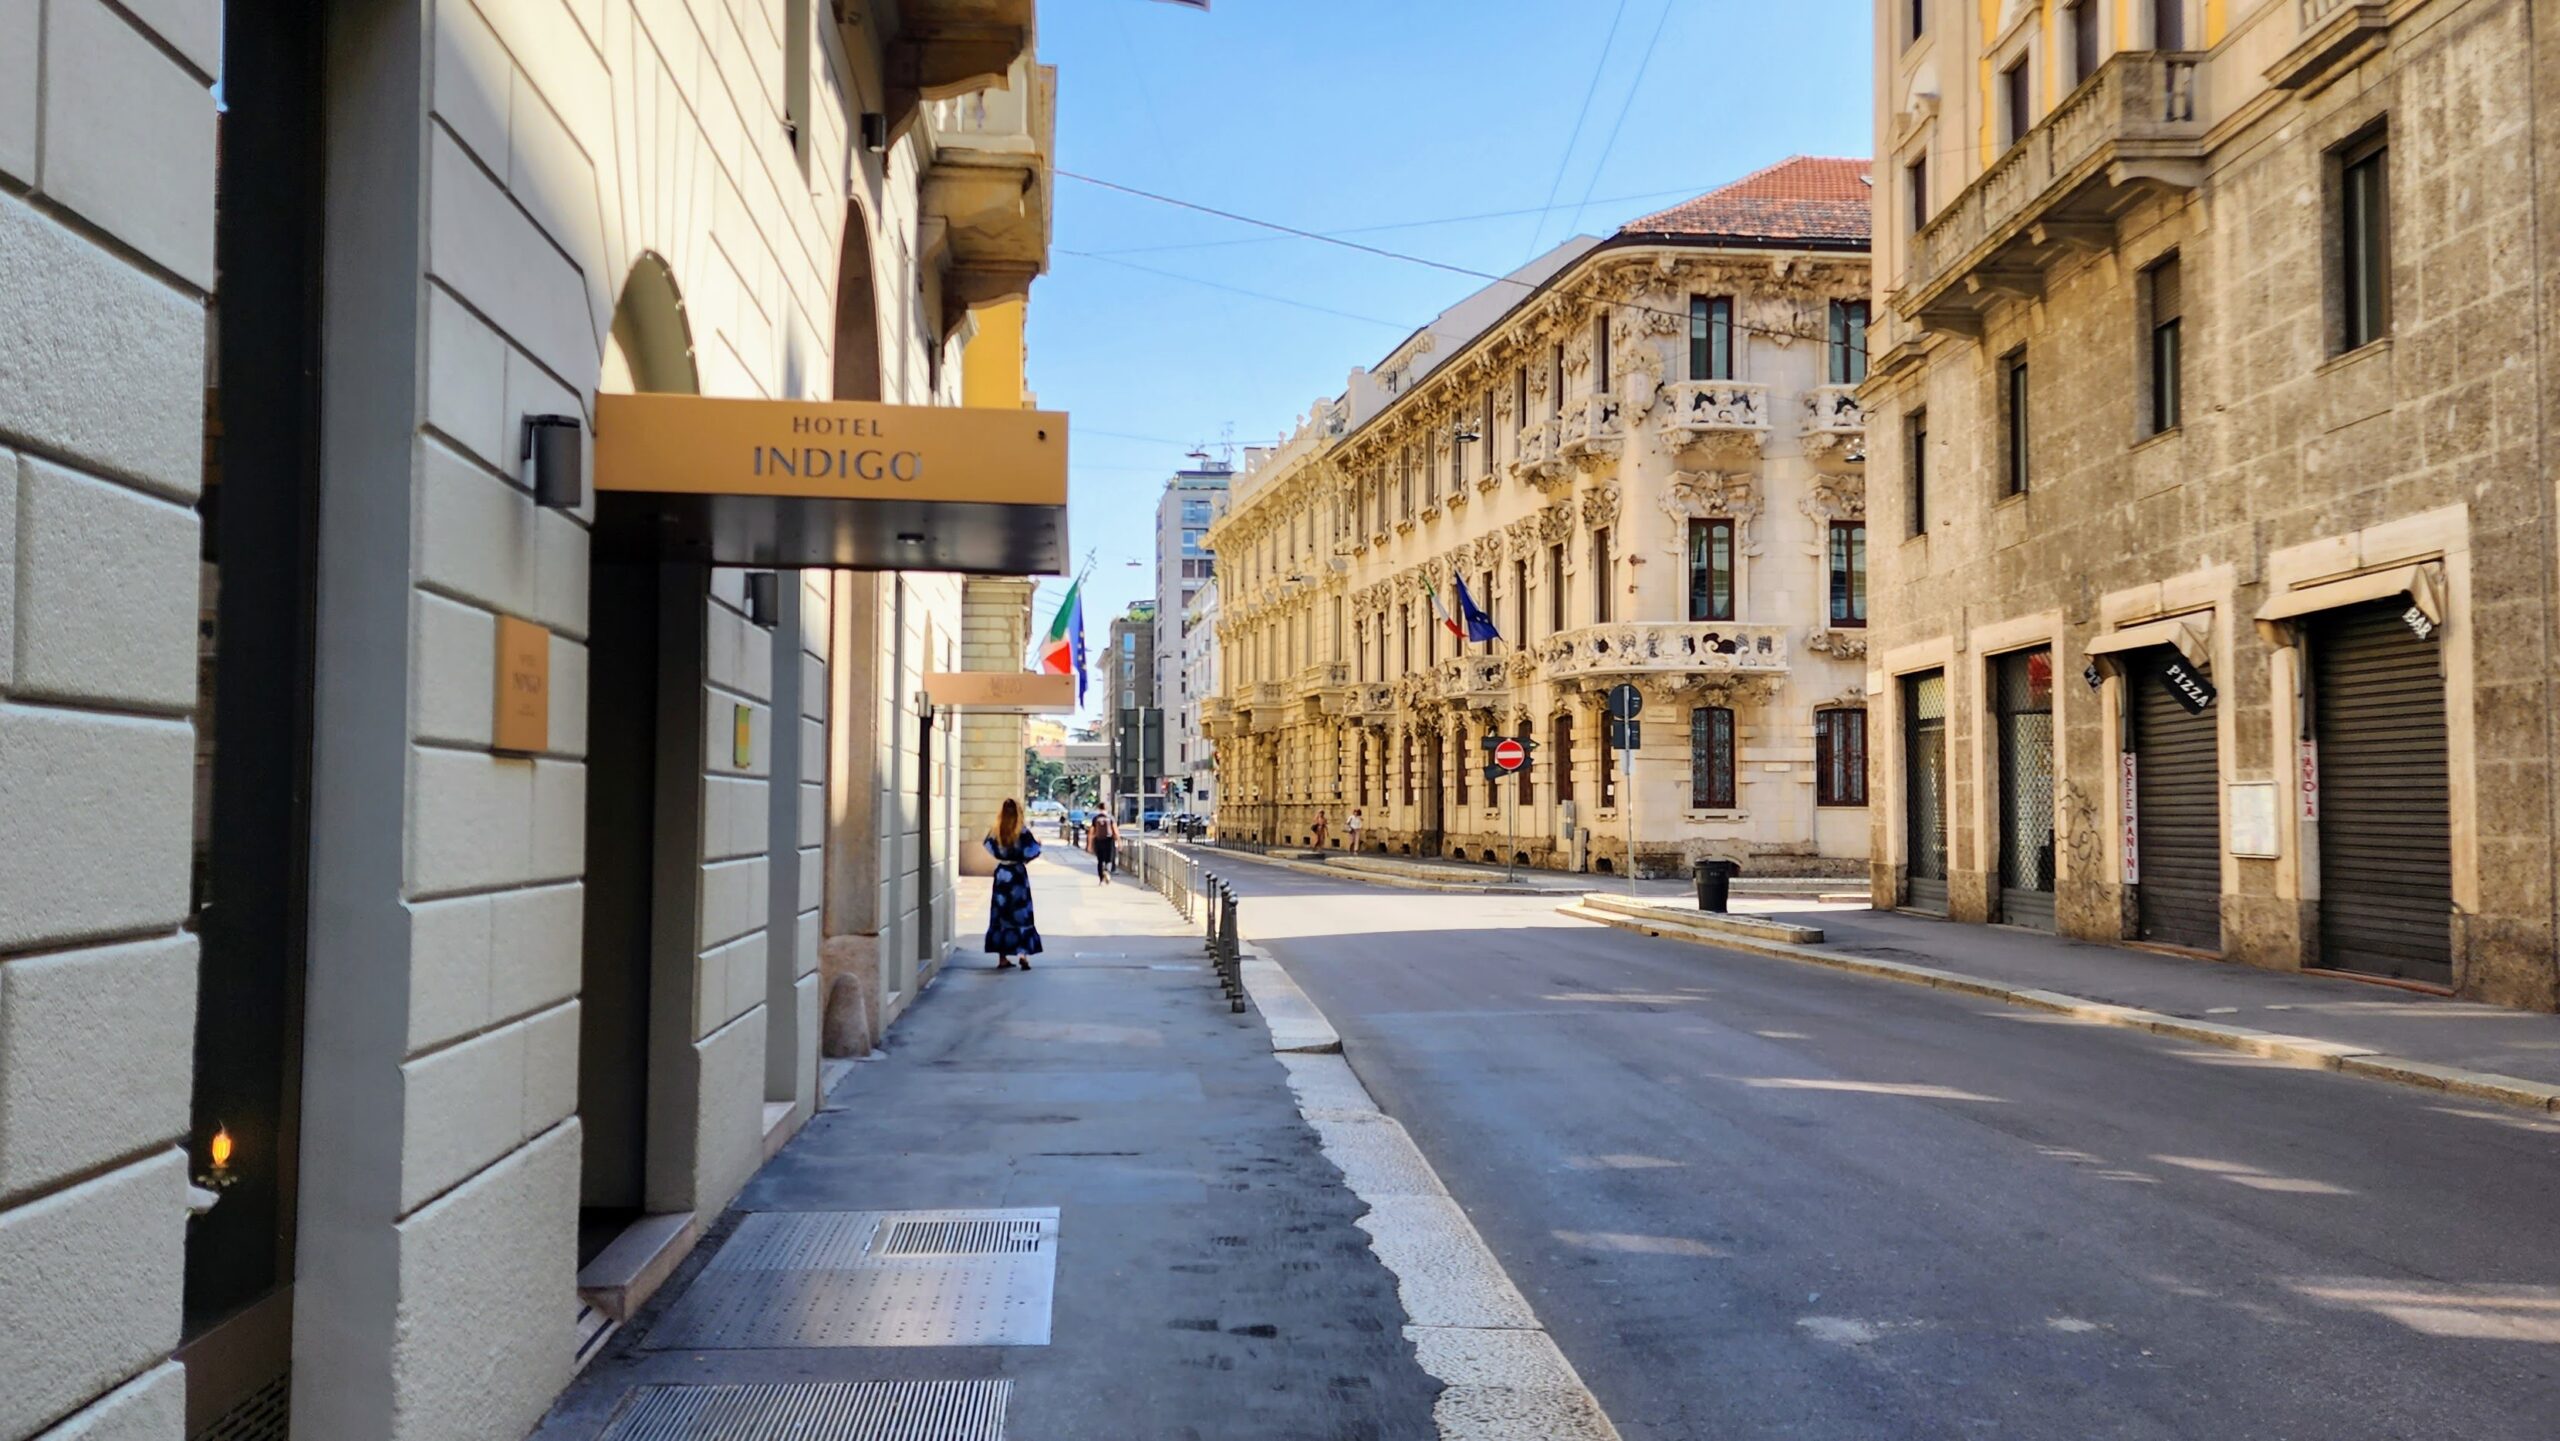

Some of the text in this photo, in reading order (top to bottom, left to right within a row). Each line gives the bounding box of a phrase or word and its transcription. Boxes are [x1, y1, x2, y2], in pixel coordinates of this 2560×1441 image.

[792, 416, 884, 438] HOTEL
[753, 446, 924, 482] INDIGO
[2402, 606, 2433, 640] BAR
[2165, 664, 2210, 708] PIZZA
[2301, 742, 2317, 818] TAVOLA
[2124, 814, 2136, 880] PANINI
